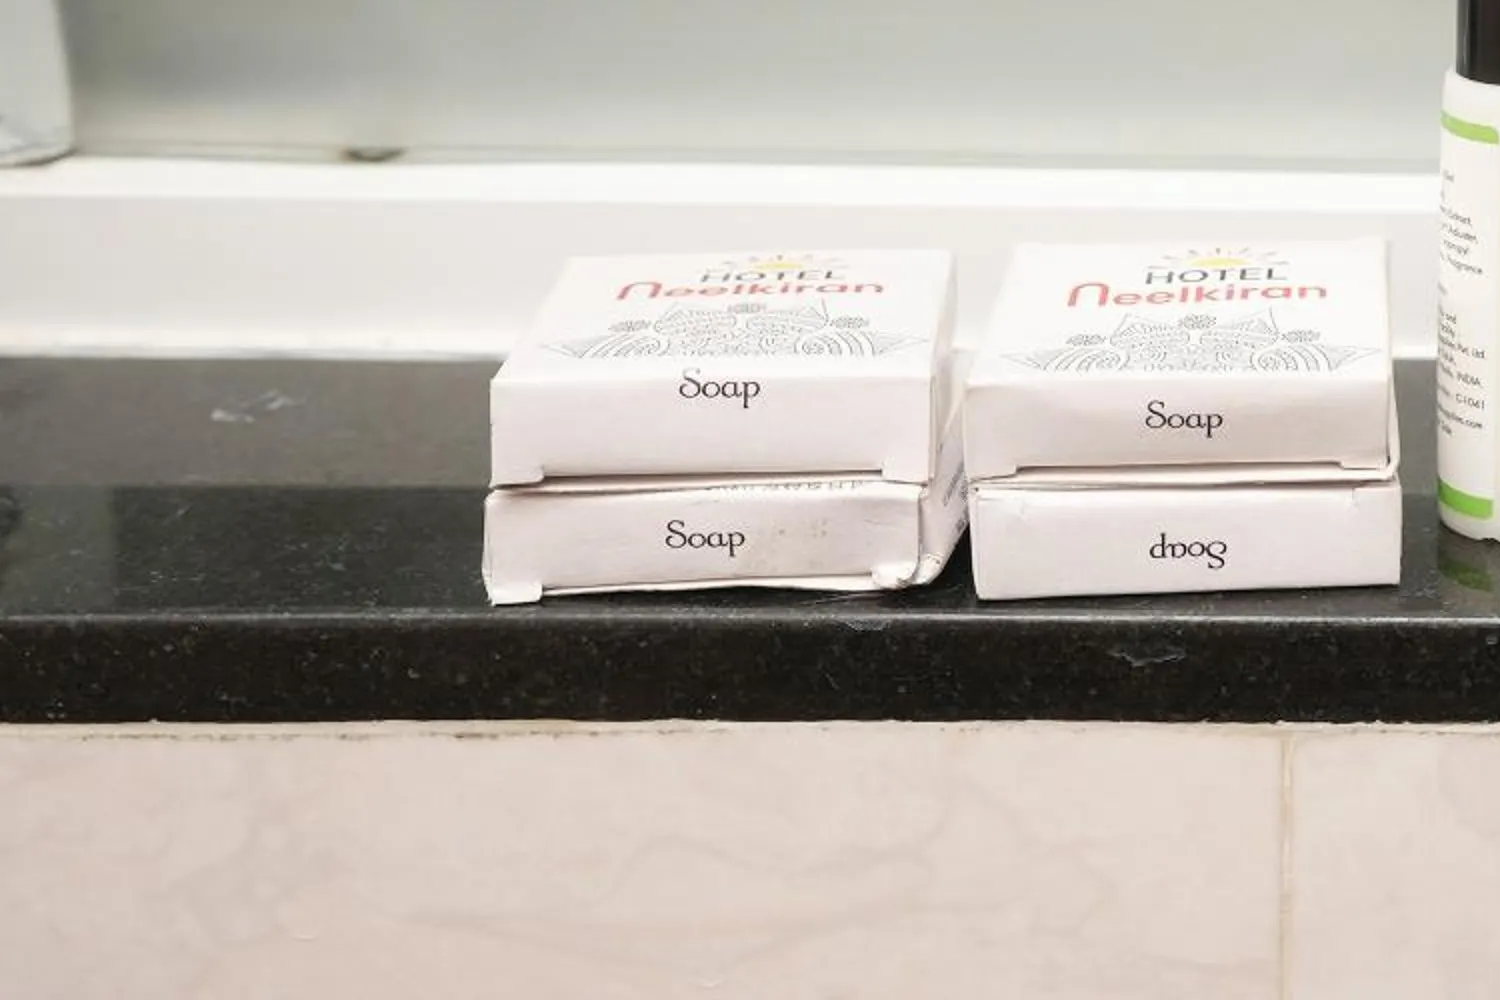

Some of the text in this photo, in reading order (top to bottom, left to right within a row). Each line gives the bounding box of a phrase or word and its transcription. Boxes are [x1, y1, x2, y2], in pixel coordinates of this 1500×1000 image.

[700, 270, 846, 282] HOTEL
[1145, 267, 1288, 284] HOTEL
[678, 369, 761, 408] Soap
[1145, 401, 1223, 437] Soap
[664, 520, 746, 556] Soap
[1149, 533, 1228, 569] Soap
